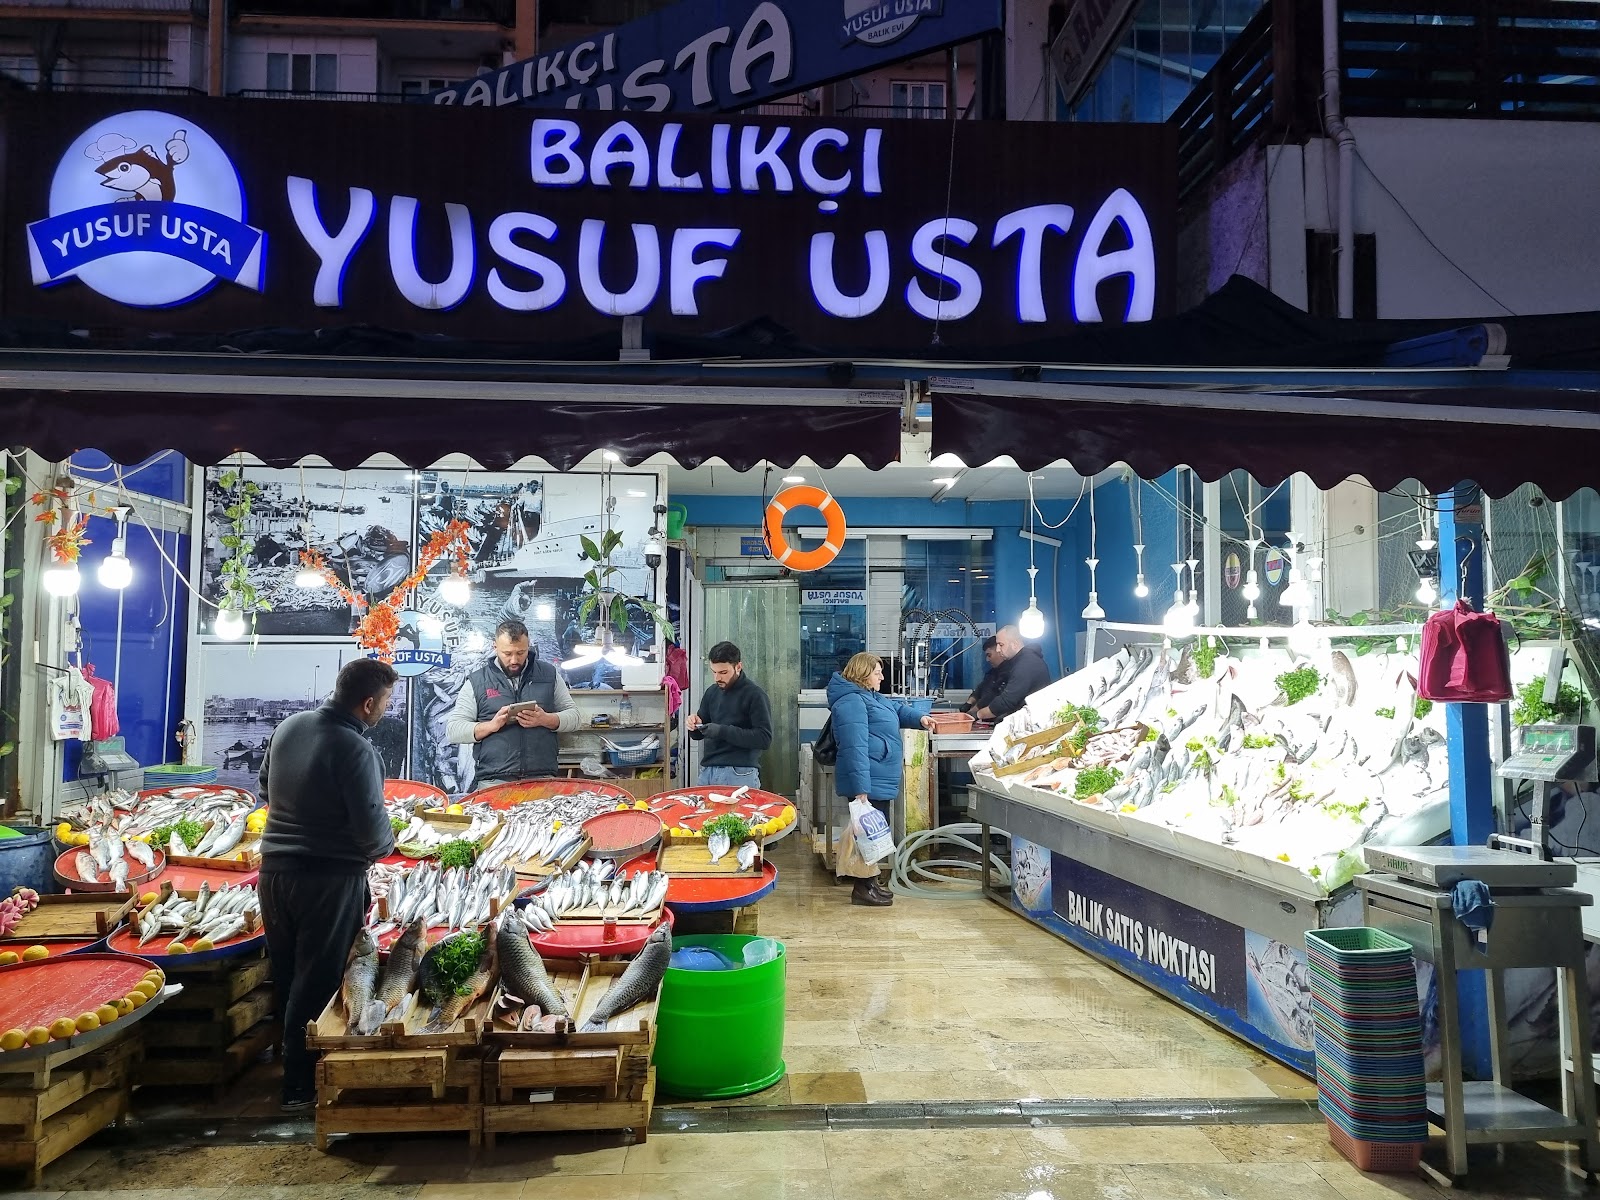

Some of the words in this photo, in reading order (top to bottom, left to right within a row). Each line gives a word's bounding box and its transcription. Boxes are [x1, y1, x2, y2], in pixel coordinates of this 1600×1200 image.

[842, 4, 890, 37] YUSUF
[867, 26, 890, 40] BALIK
[530, 118, 883, 213] BALIKÇI
[52, 213, 151, 258] YUSUF
[160, 216, 233, 266] USTA
[286, 175, 742, 317] YUSUF
[809, 187, 1157, 323] USTA
[414, 651, 444, 665] USTA
[1068, 889, 1104, 937] BALIK
[1106, 907, 1144, 961] SATIŞ
[1147, 925, 1216, 994] NOKTASI
